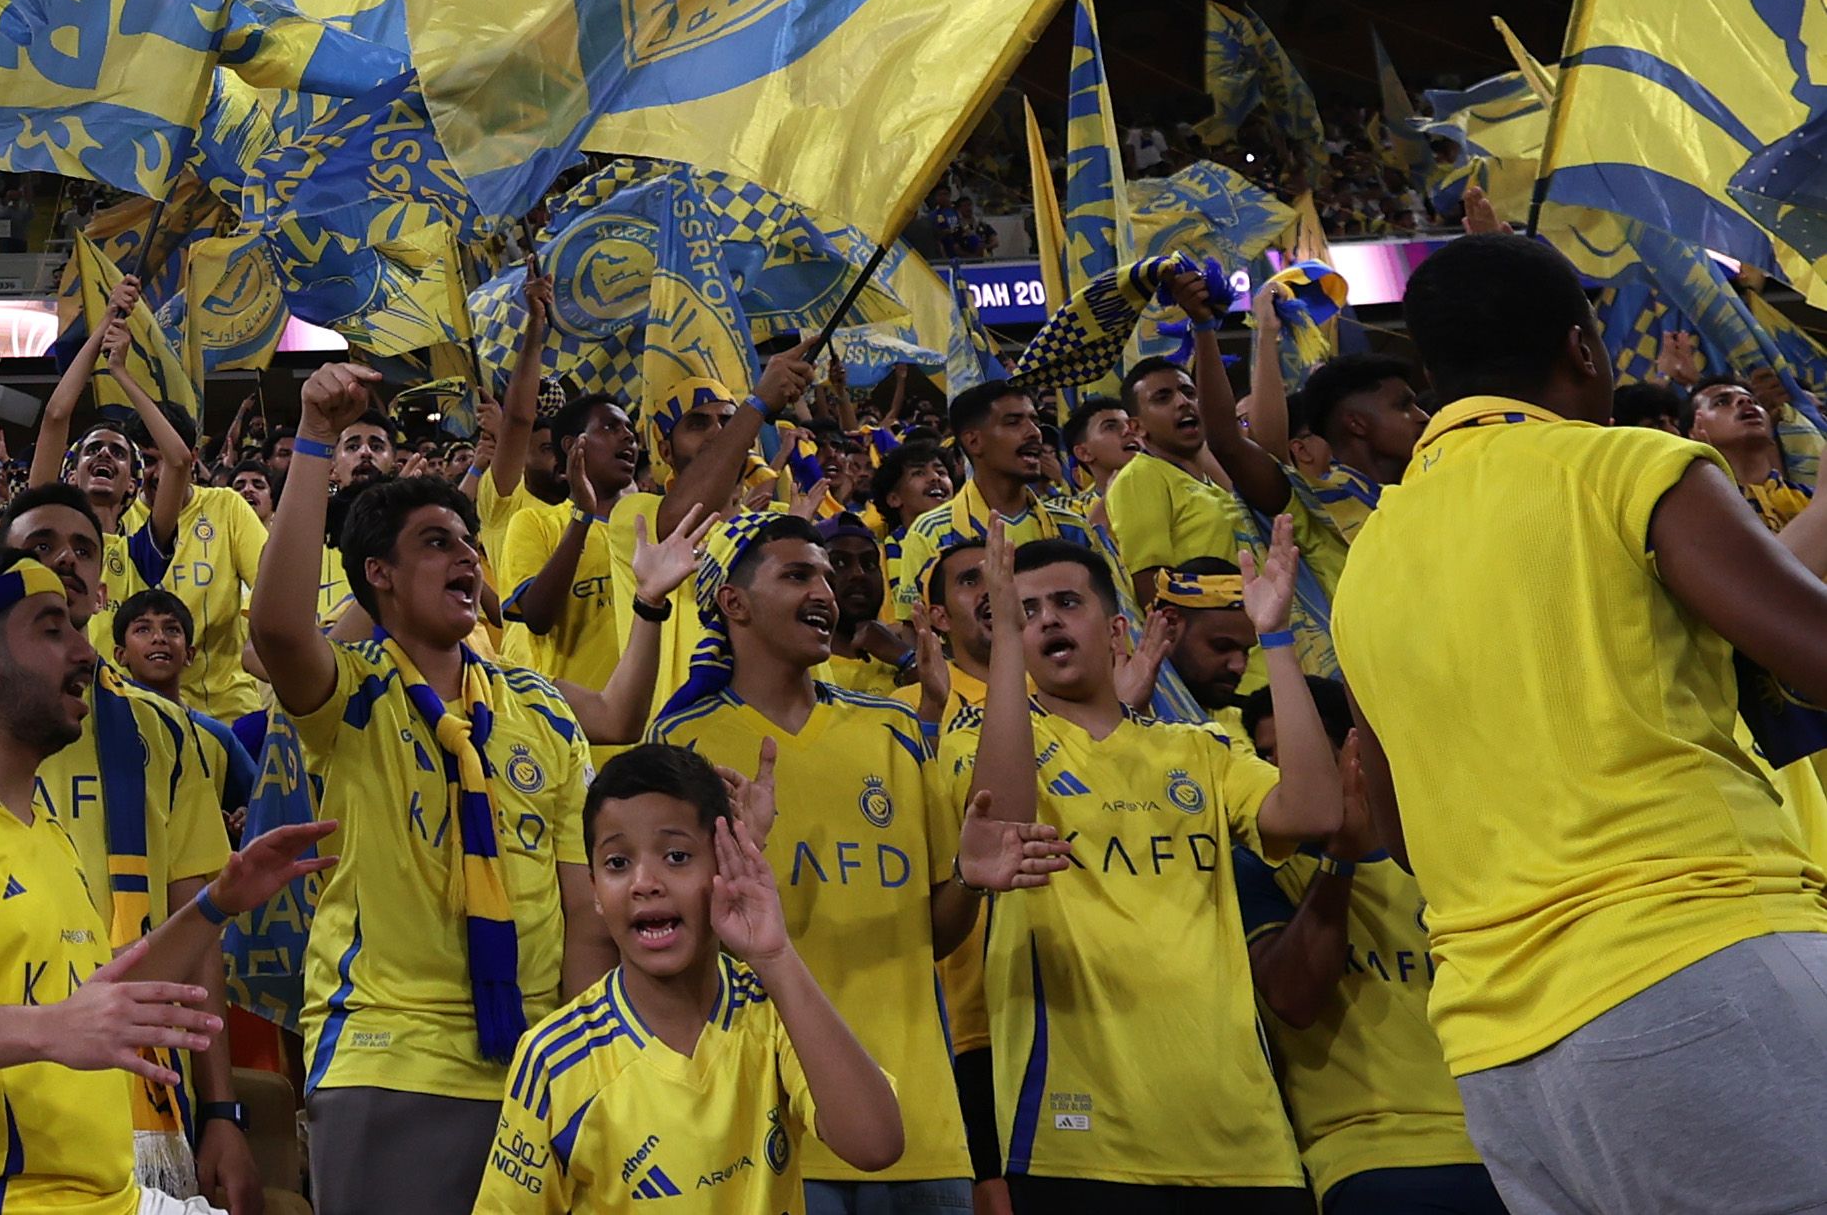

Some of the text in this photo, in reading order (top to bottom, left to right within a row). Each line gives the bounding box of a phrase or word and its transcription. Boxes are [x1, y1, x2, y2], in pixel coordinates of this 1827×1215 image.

[1016, 280, 1046, 306] 20
[790, 840, 912, 890] AFD
[490, 1149, 544, 1195] NOUG
